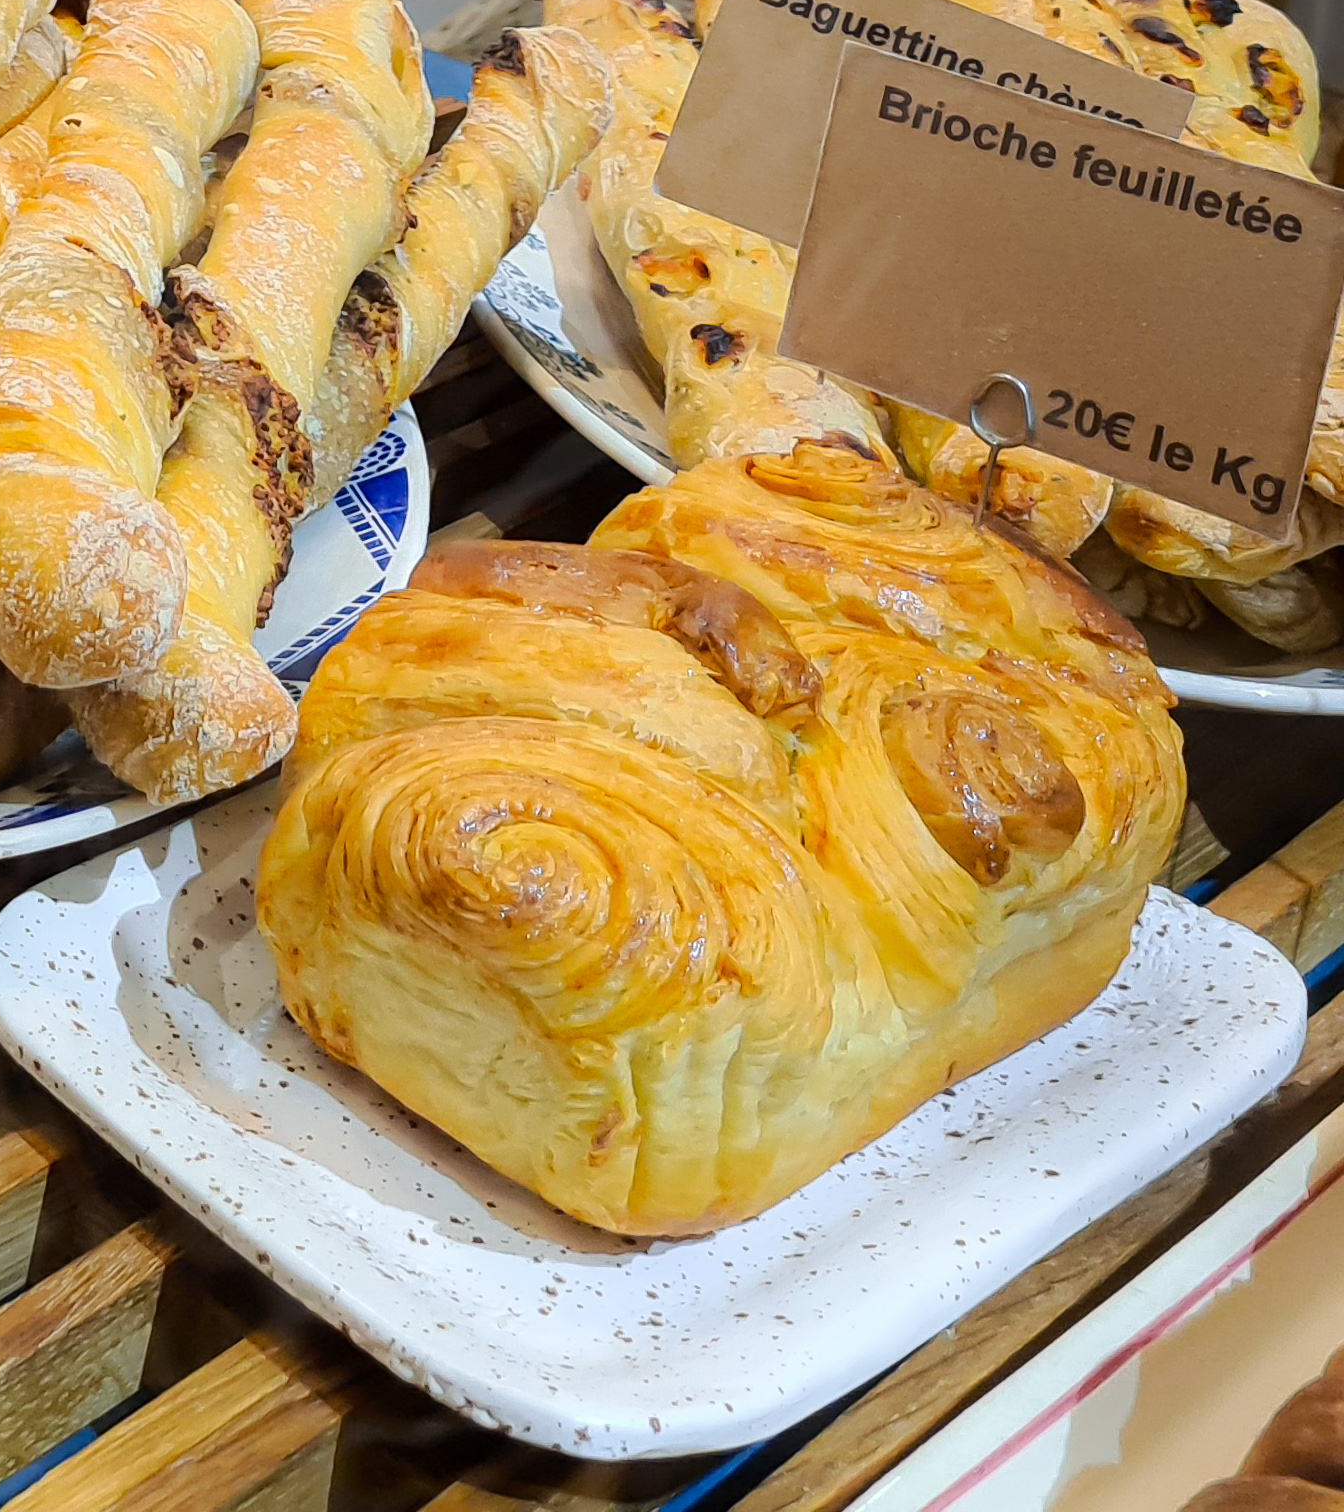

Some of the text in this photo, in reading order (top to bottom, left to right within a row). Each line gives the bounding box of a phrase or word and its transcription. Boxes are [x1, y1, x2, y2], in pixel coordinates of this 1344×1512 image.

[876, 84, 1303, 243] Brioche feuilletée
[1043, 389, 1286, 515] 20€ le Kg
